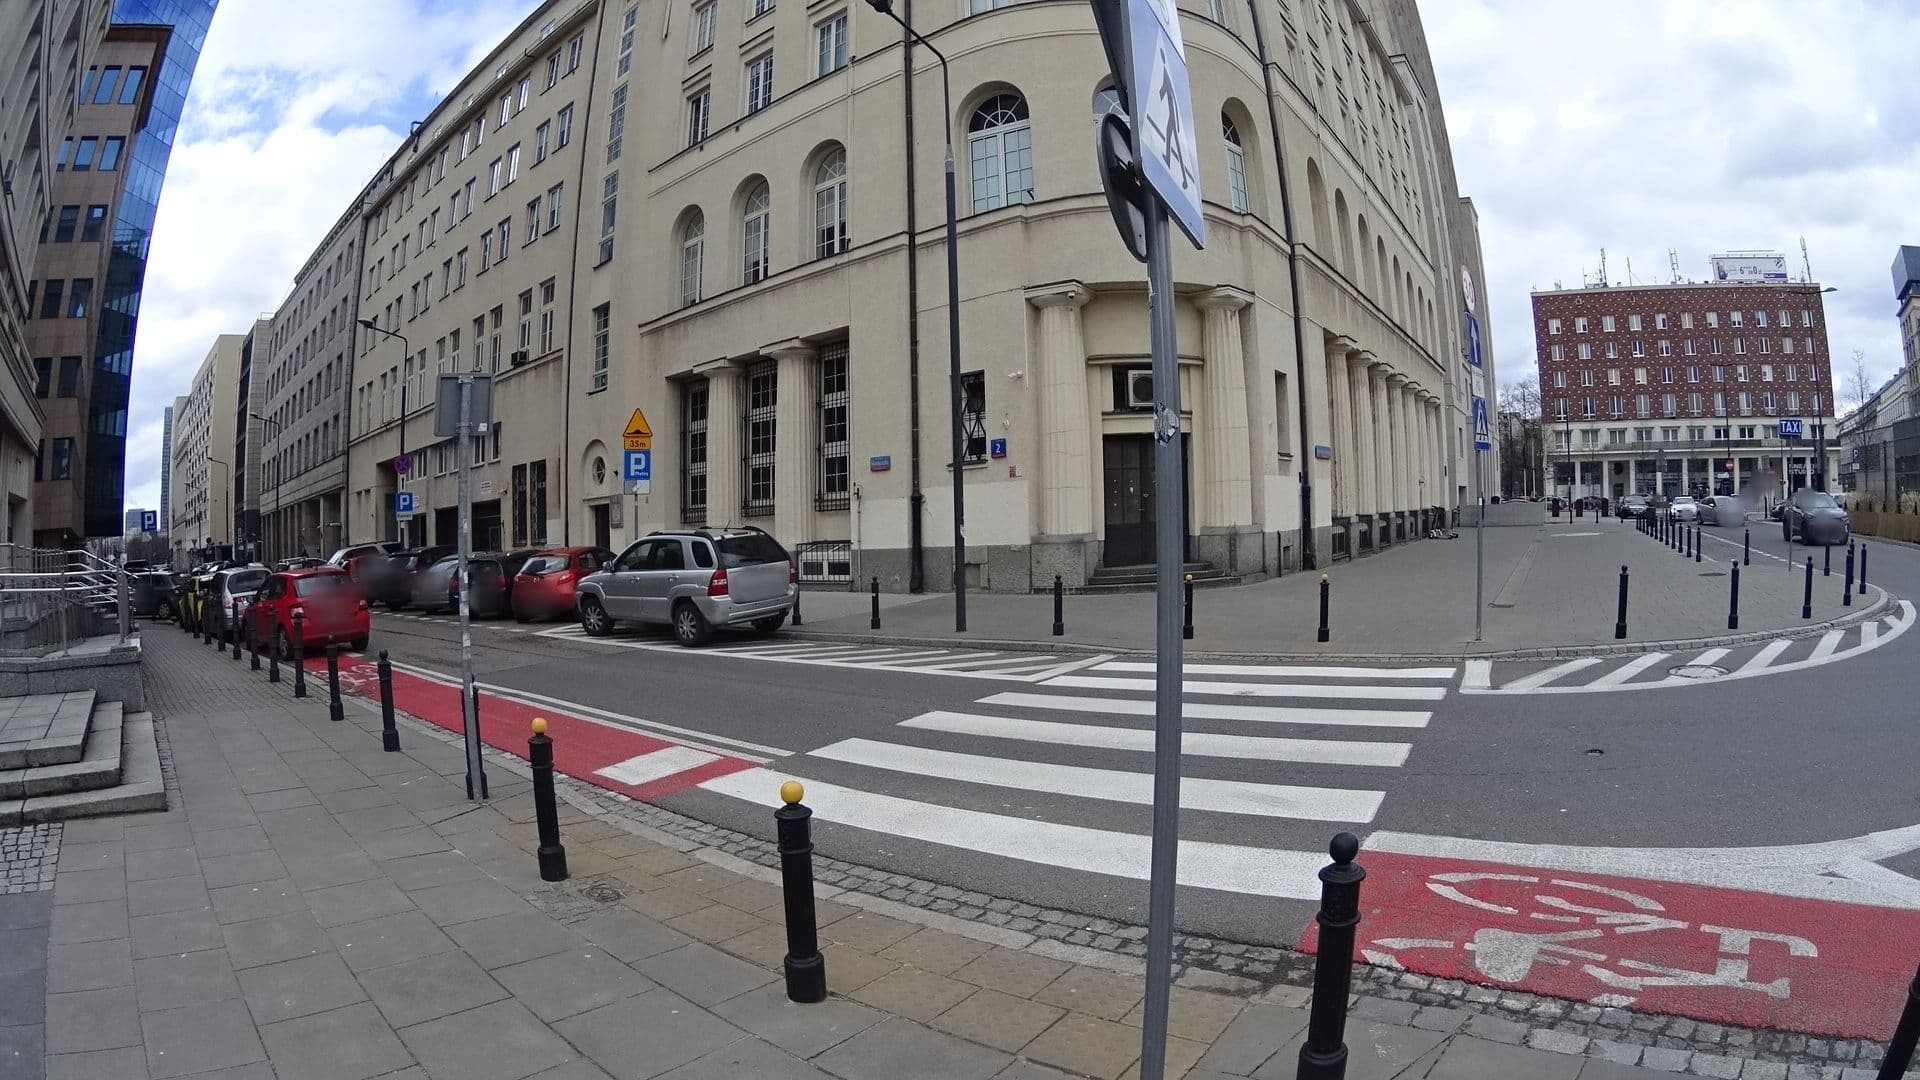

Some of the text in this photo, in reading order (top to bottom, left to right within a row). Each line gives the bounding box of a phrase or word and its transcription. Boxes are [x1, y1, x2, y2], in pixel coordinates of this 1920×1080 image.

[1739, 266, 1745, 275] 6
[1752, 265, 1758, 275] 0
[1780, 420, 1802, 433] TAXI
[629, 439, 647, 448] 35m
[995, 443, 1001, 453] 2
[630, 453, 646, 476] P
[399, 494, 410, 510] P
[144, 513, 154, 530] P
